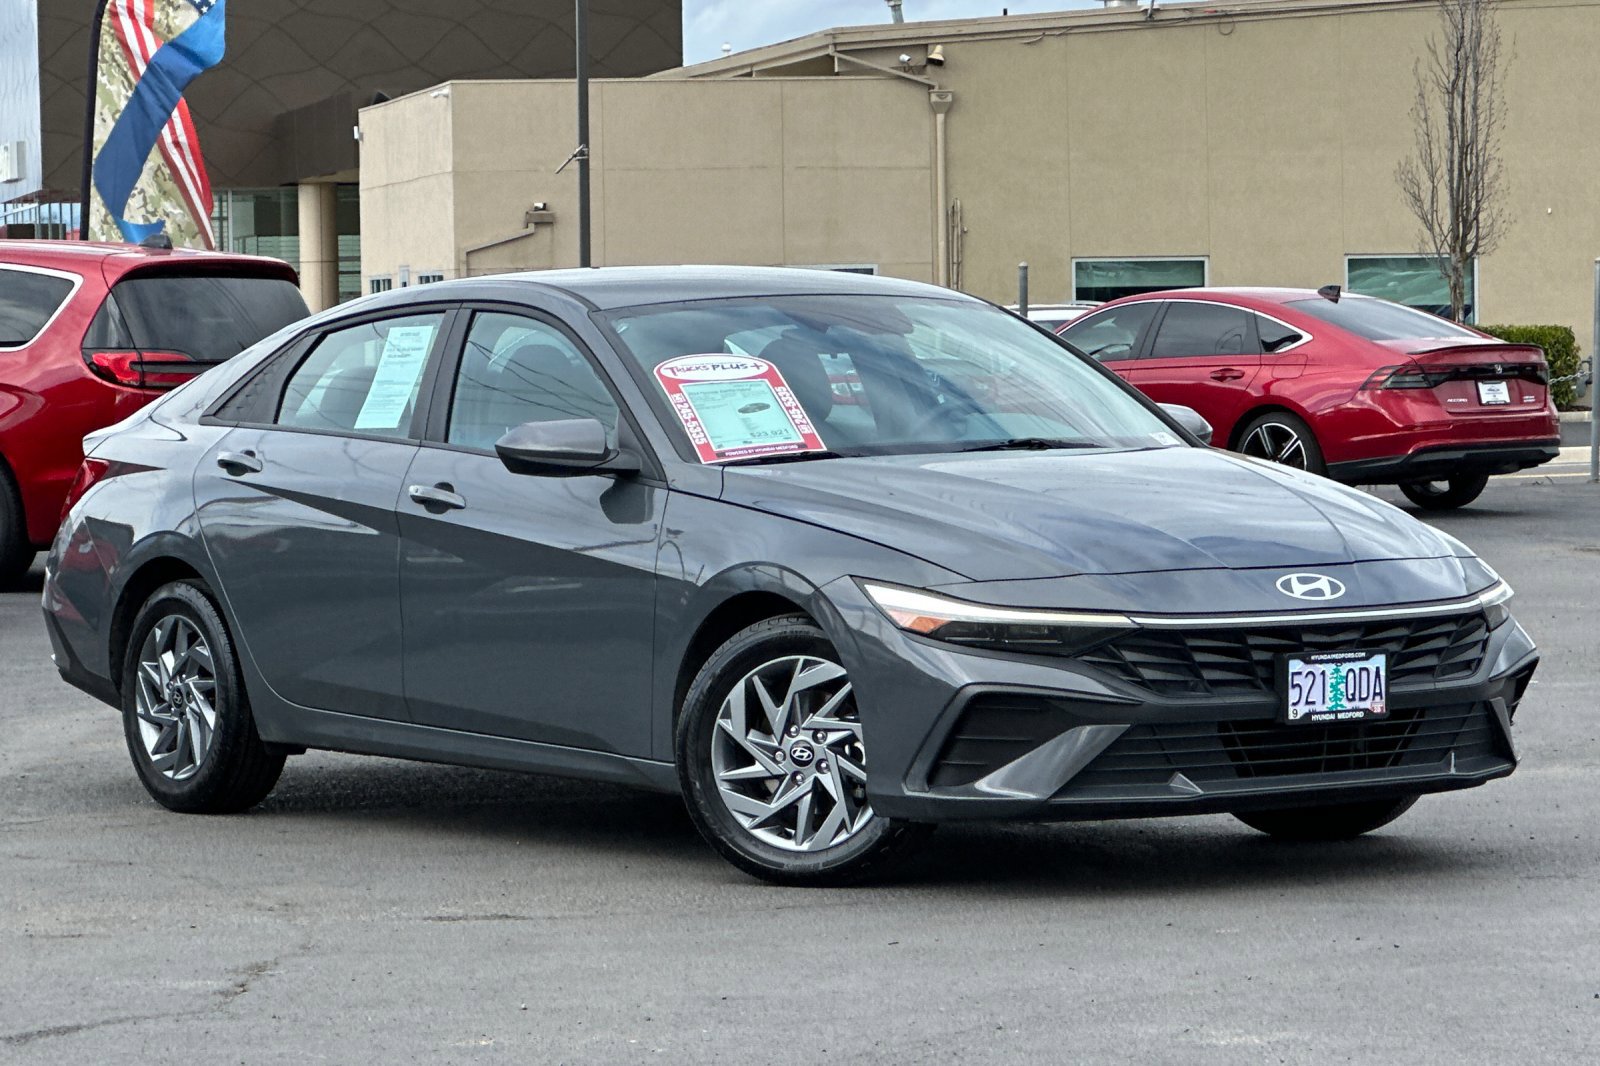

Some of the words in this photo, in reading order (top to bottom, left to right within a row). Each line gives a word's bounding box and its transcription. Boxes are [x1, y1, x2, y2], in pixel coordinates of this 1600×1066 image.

[1290, 670, 1327, 706] 521
[1345, 666, 1384, 702] QDA
[1292, 708, 1298, 718] 9
[1337, 711, 1365, 719] MEDFORD
